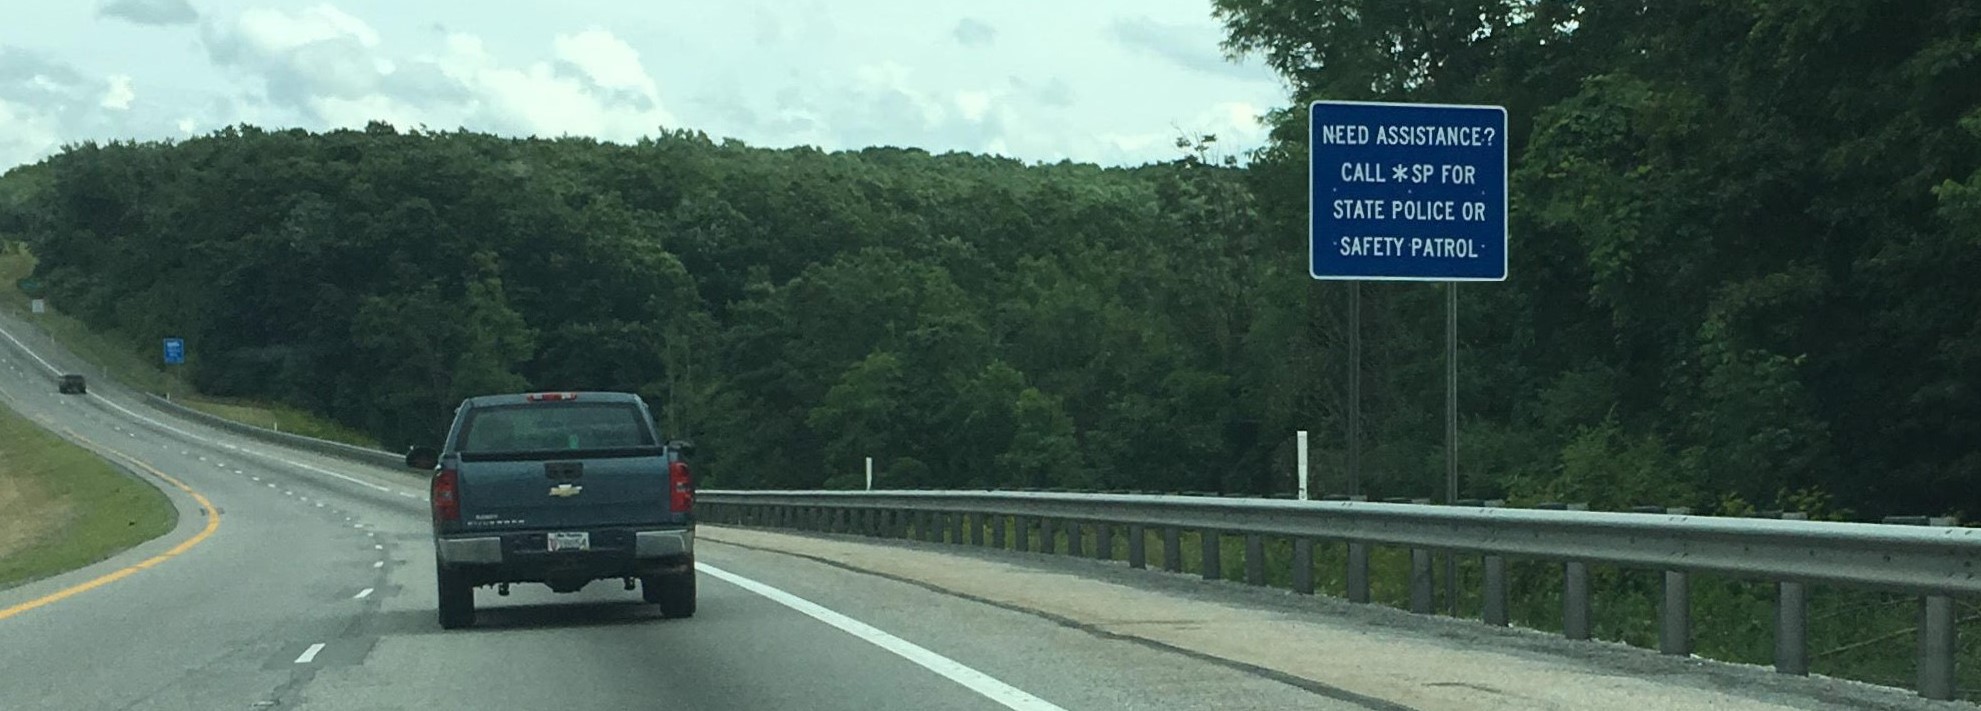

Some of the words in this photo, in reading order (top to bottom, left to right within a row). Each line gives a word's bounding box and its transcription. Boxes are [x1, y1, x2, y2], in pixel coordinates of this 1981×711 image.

[1323, 125, 1369, 144] NEED
[1376, 126, 1495, 146] ASSISTANCE?
[1341, 162, 1386, 182] CALL
[1442, 165, 1475, 184] FOR
[1333, 200, 1385, 219] STATE
[1392, 201, 1455, 220] POLICE
[1462, 202, 1485, 221] OR
[1340, 237, 1404, 256] SAFETY
[1411, 238, 1478, 257] PATROL
